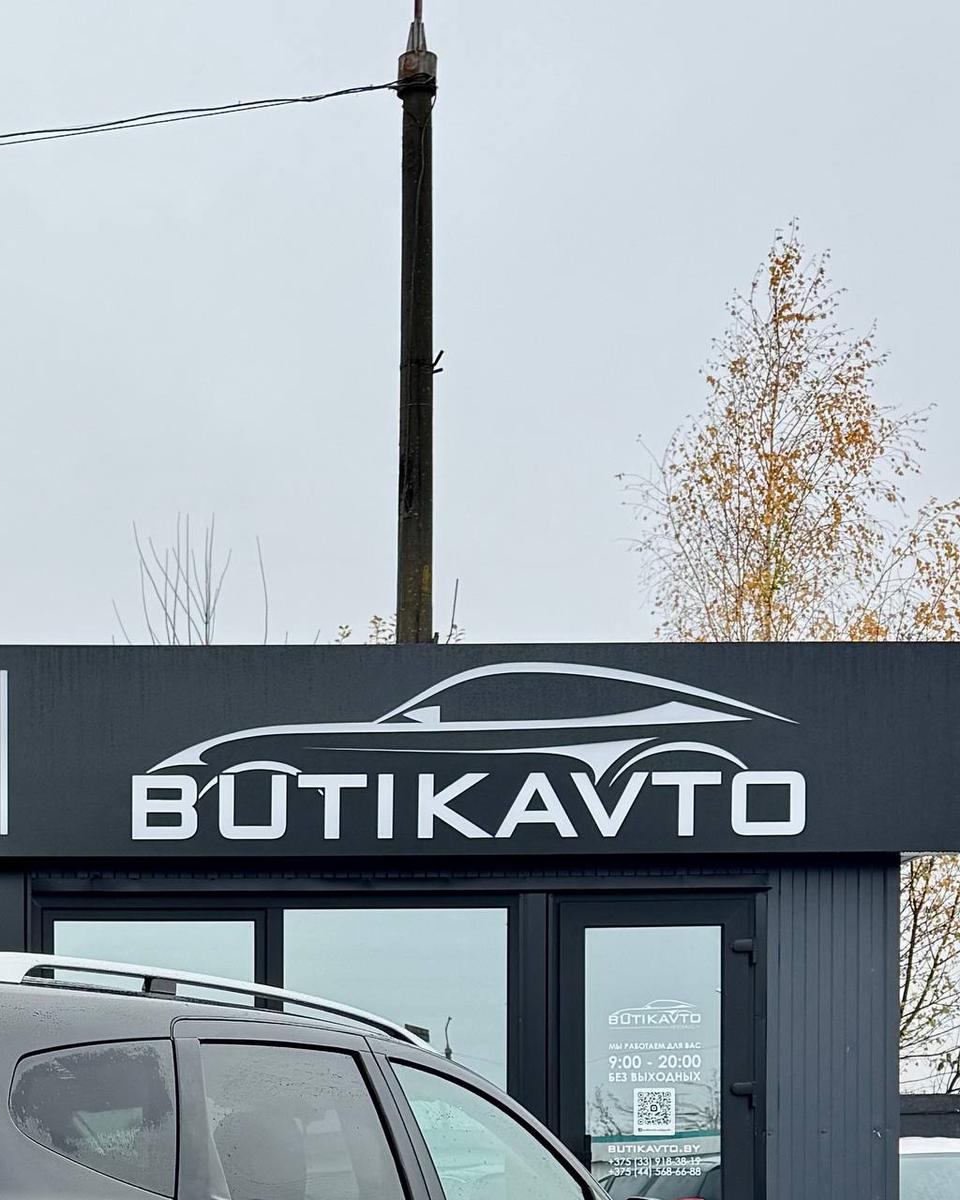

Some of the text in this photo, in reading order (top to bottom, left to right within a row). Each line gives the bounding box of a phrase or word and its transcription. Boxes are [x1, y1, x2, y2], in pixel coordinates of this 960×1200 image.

[131, 770, 806, 841] BUTIKAVTO
[608, 1013, 701, 1025] BUTIKAVTO
[667, 1042, 683, 1050] ДЛЯ
[608, 1055, 642, 1069] 9:00
[658, 1054, 701, 1068] 20:00
[608, 1071, 701, 1082] БЕЗ ВЫХОДНЫХ
[608, 1145, 701, 1153] BUTIKAVTO.BY
[608, 1157, 632, 1166] +375
[634, 1157, 652, 1168] (33)
[608, 1167, 701, 1178] +375 (44) 568-66-88
